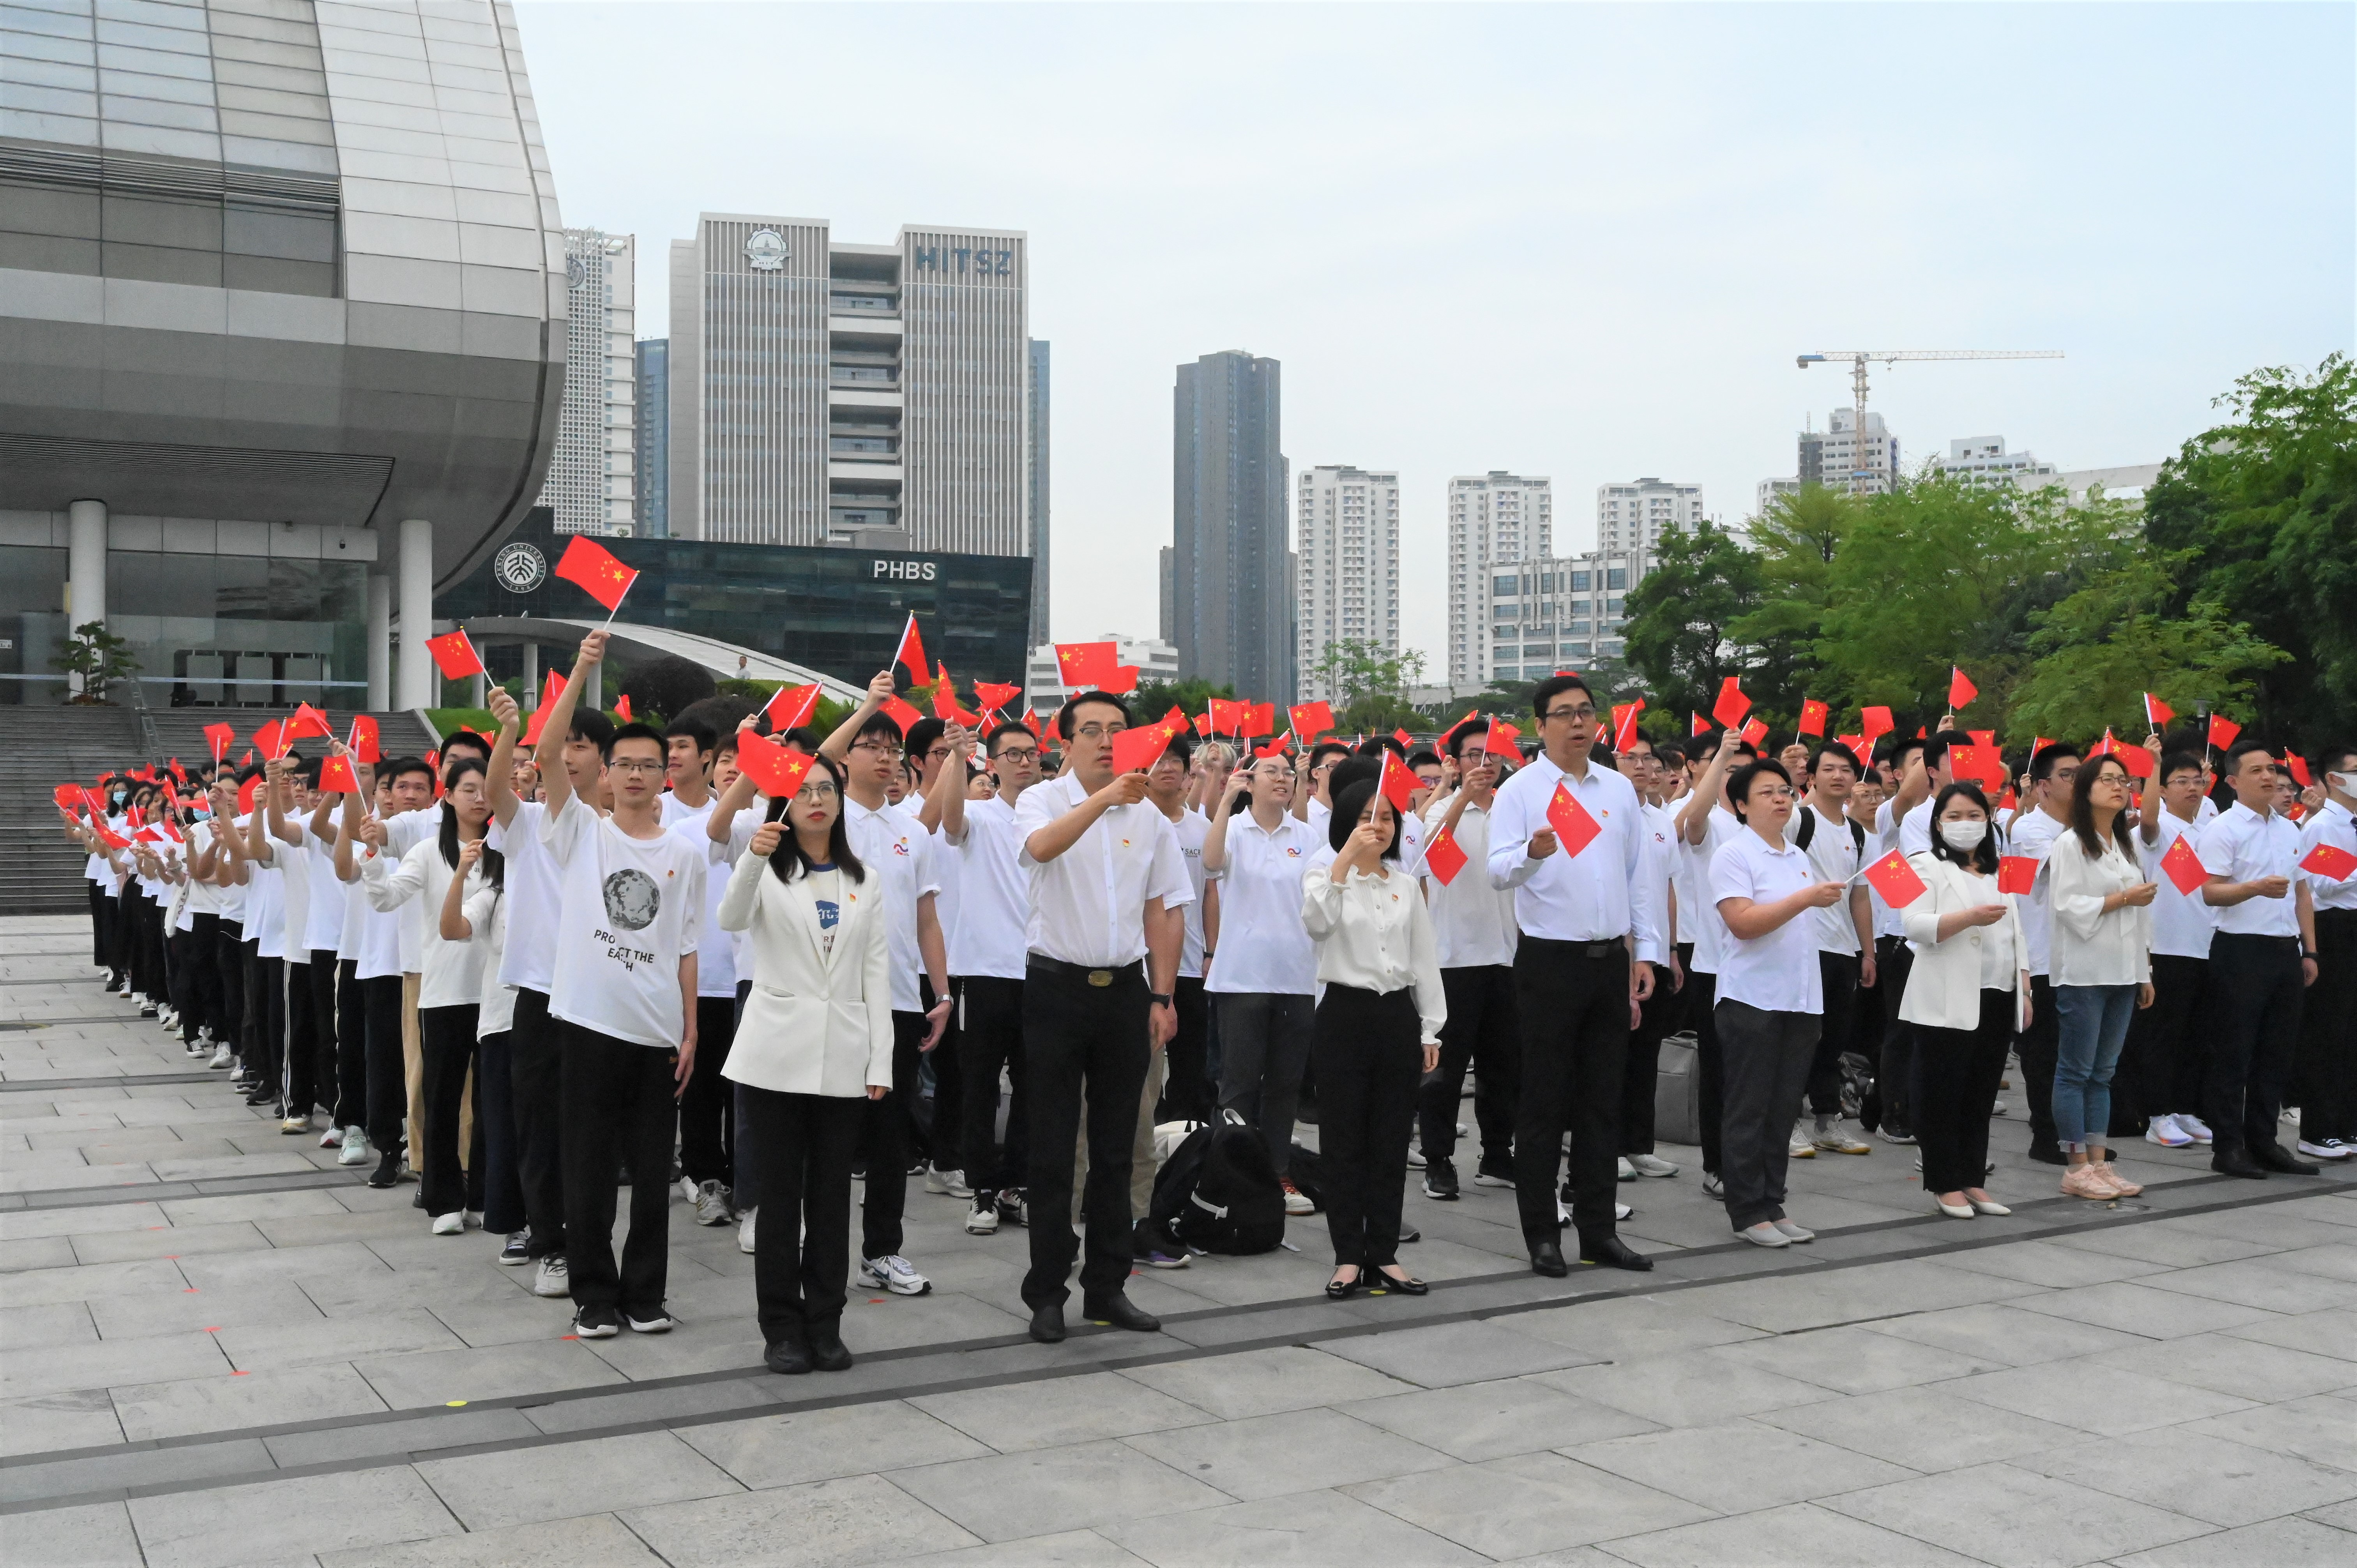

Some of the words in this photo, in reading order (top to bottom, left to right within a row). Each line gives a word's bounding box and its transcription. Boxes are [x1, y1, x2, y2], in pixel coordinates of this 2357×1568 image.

[917, 246, 1011, 275] HITSZ
[497, 548, 510, 577] PEKING
[513, 544, 544, 578] UNIVERSITY
[874, 560, 936, 580] PHBS
[634, 950, 654, 963] THE
